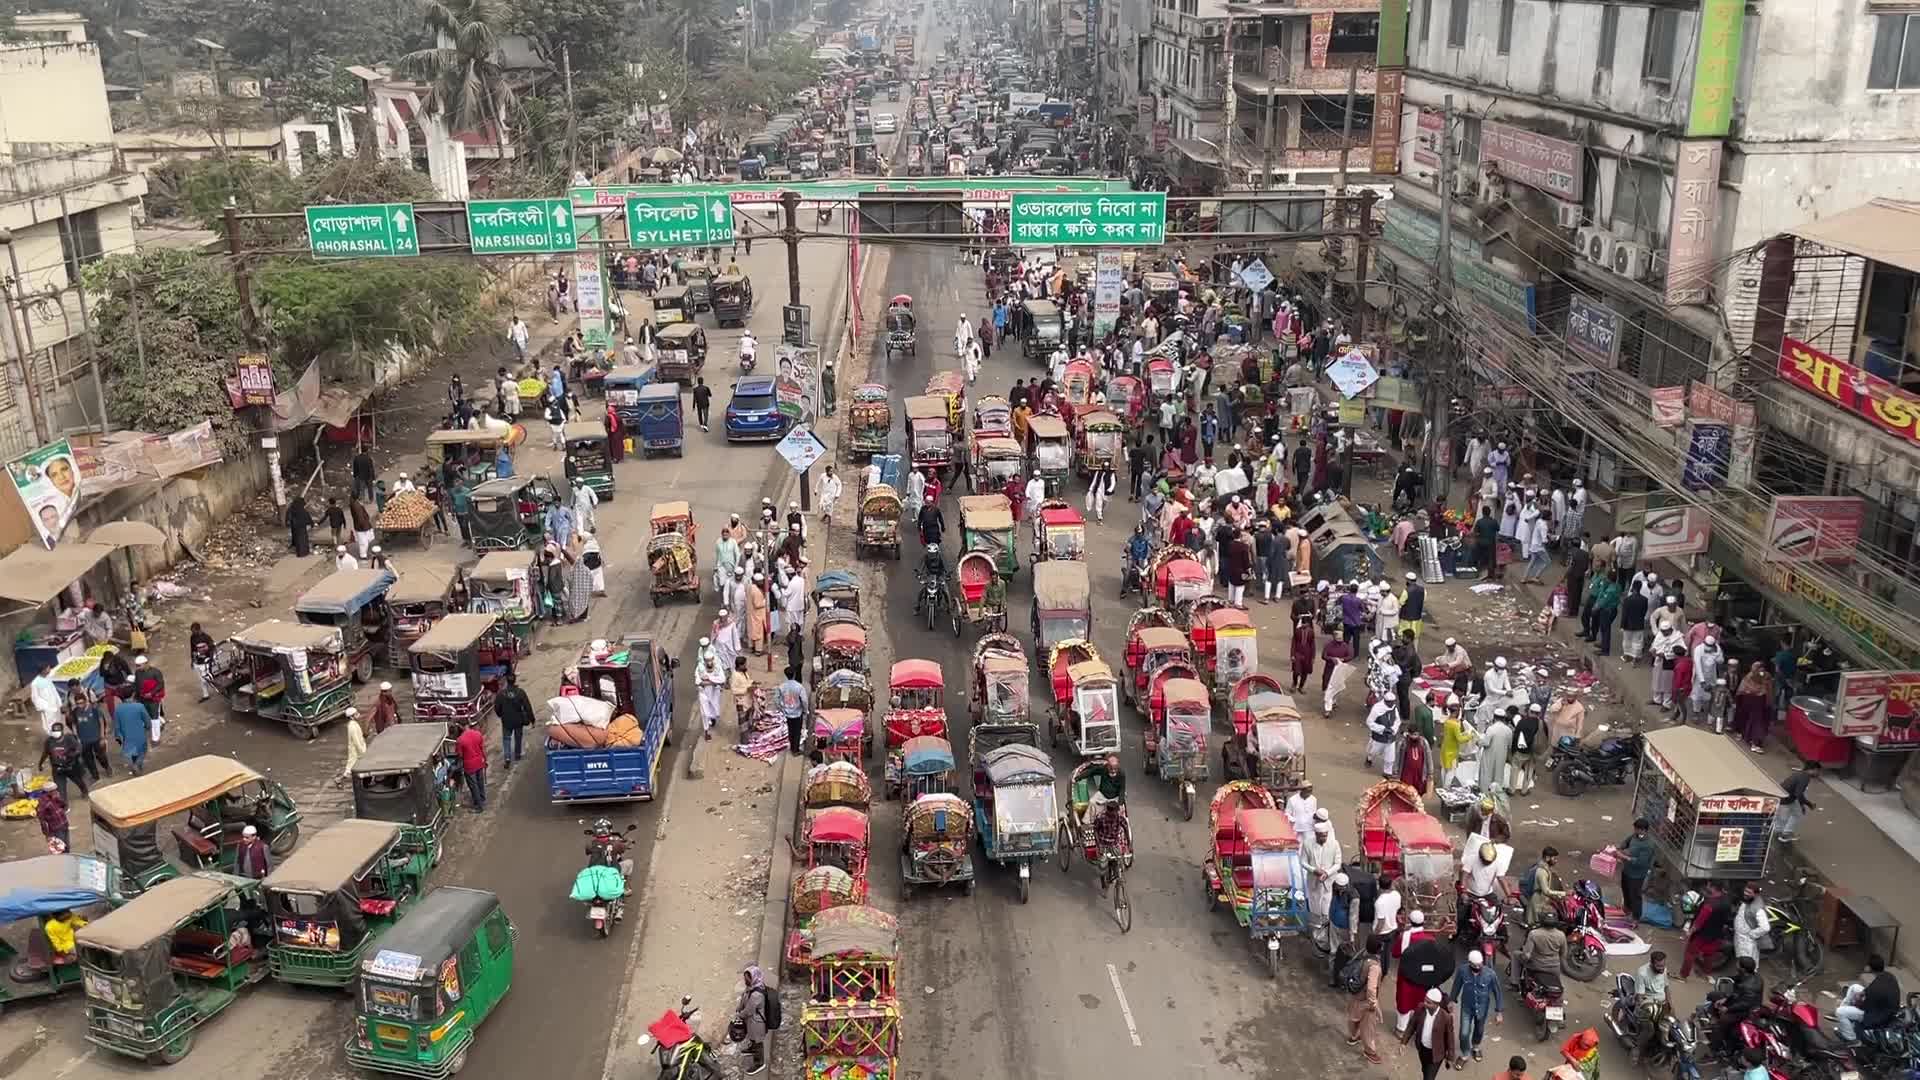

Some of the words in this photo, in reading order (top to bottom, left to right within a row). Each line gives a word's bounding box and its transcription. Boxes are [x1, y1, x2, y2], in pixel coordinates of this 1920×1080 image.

[472, 206, 544, 227] নরসিংদী
[634, 202, 700, 222] সিলেট
[1017, 200, 1093, 217] ওভারলোড
[1097, 197, 1136, 217] নিবো
[1141, 201, 1157, 217] না
[313, 216, 383, 235] ঘোড়াশাল
[1017, 222, 1059, 238] রাস্তার
[1064, 218, 1097, 238] ক্ষতি
[1102, 223, 1136, 238] করব
[316, 239, 388, 252] GHORASHAL
[396, 238, 413, 250] 24
[474, 233, 548, 248] NARSINGDI
[555, 232, 571, 245] 39
[636, 228, 702, 243] SYLHET
[709, 228, 731, 241] 230
